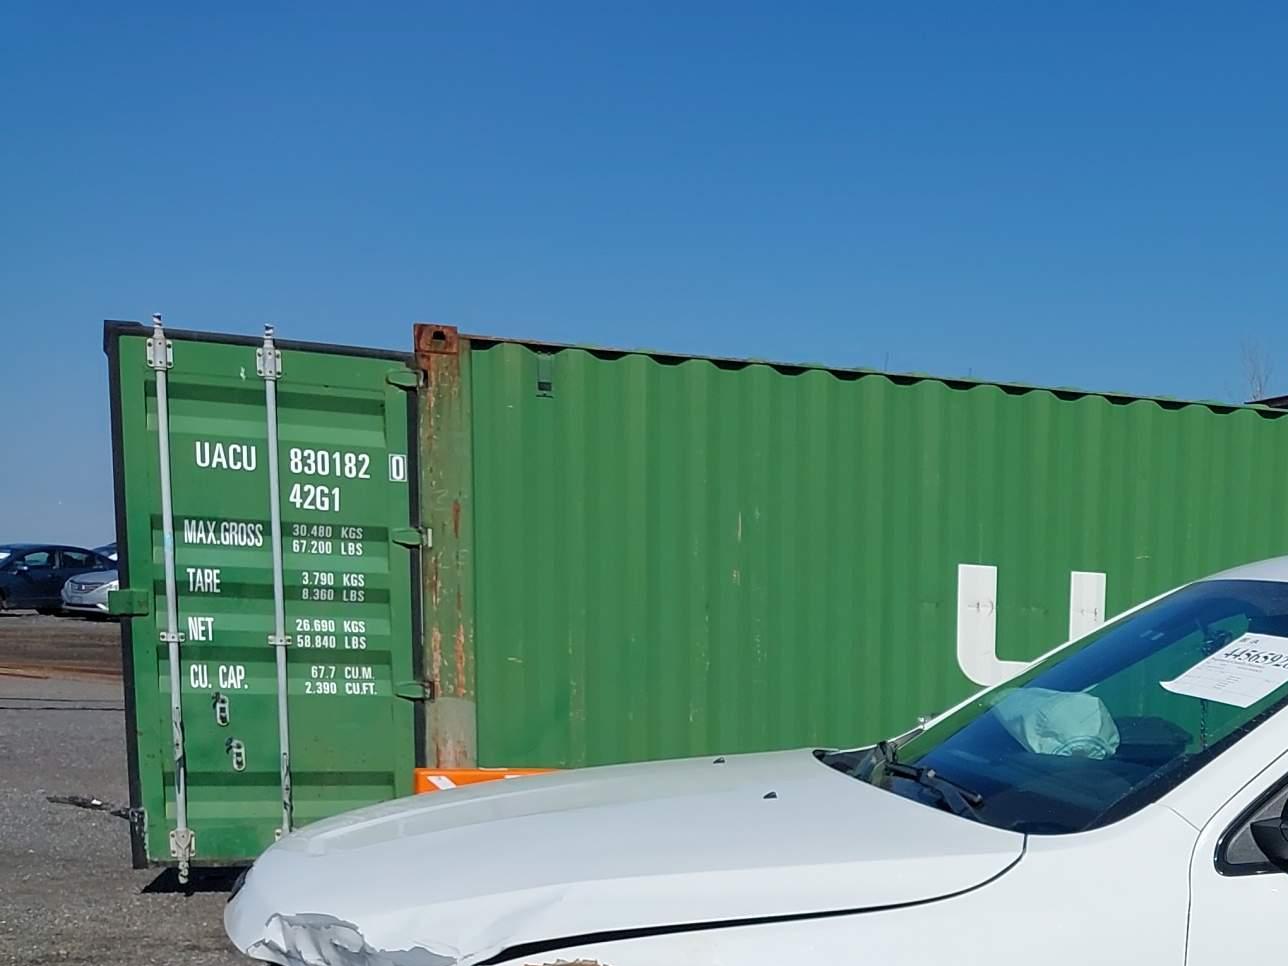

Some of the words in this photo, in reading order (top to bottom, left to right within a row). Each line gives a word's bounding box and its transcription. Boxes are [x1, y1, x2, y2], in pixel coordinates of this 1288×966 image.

[195, 441, 257, 471] UACU
[289, 448, 371, 480] 830182
[390, 454, 407, 482] 0
[289, 483, 341, 512] 42G1
[184, 519, 263, 548] MAX.GROSS
[292, 524, 333, 538] 30.480
[341, 527, 364, 540] KGS
[292, 540, 332, 555] 67.200
[341, 542, 363, 556] LBS
[186, 568, 221, 594] TARE
[301, 572, 335, 587] 3.790
[342, 573, 365, 587] KGS
[301, 589, 335, 602] 8.360
[342, 590, 365, 603] LBS
[188, 616, 214, 642] NET
[295, 619, 336, 633] 26.690
[343, 620, 366, 633] KGS
[296, 635, 337, 649] 58.840
[344, 636, 367, 650] LBS
[190, 664, 212, 690] CU.
[218, 665, 249, 690] CAP.
[310, 665, 336, 680] 67.7
[344, 666, 375, 680] CU.M.
[304, 681, 338, 695] 2.390
